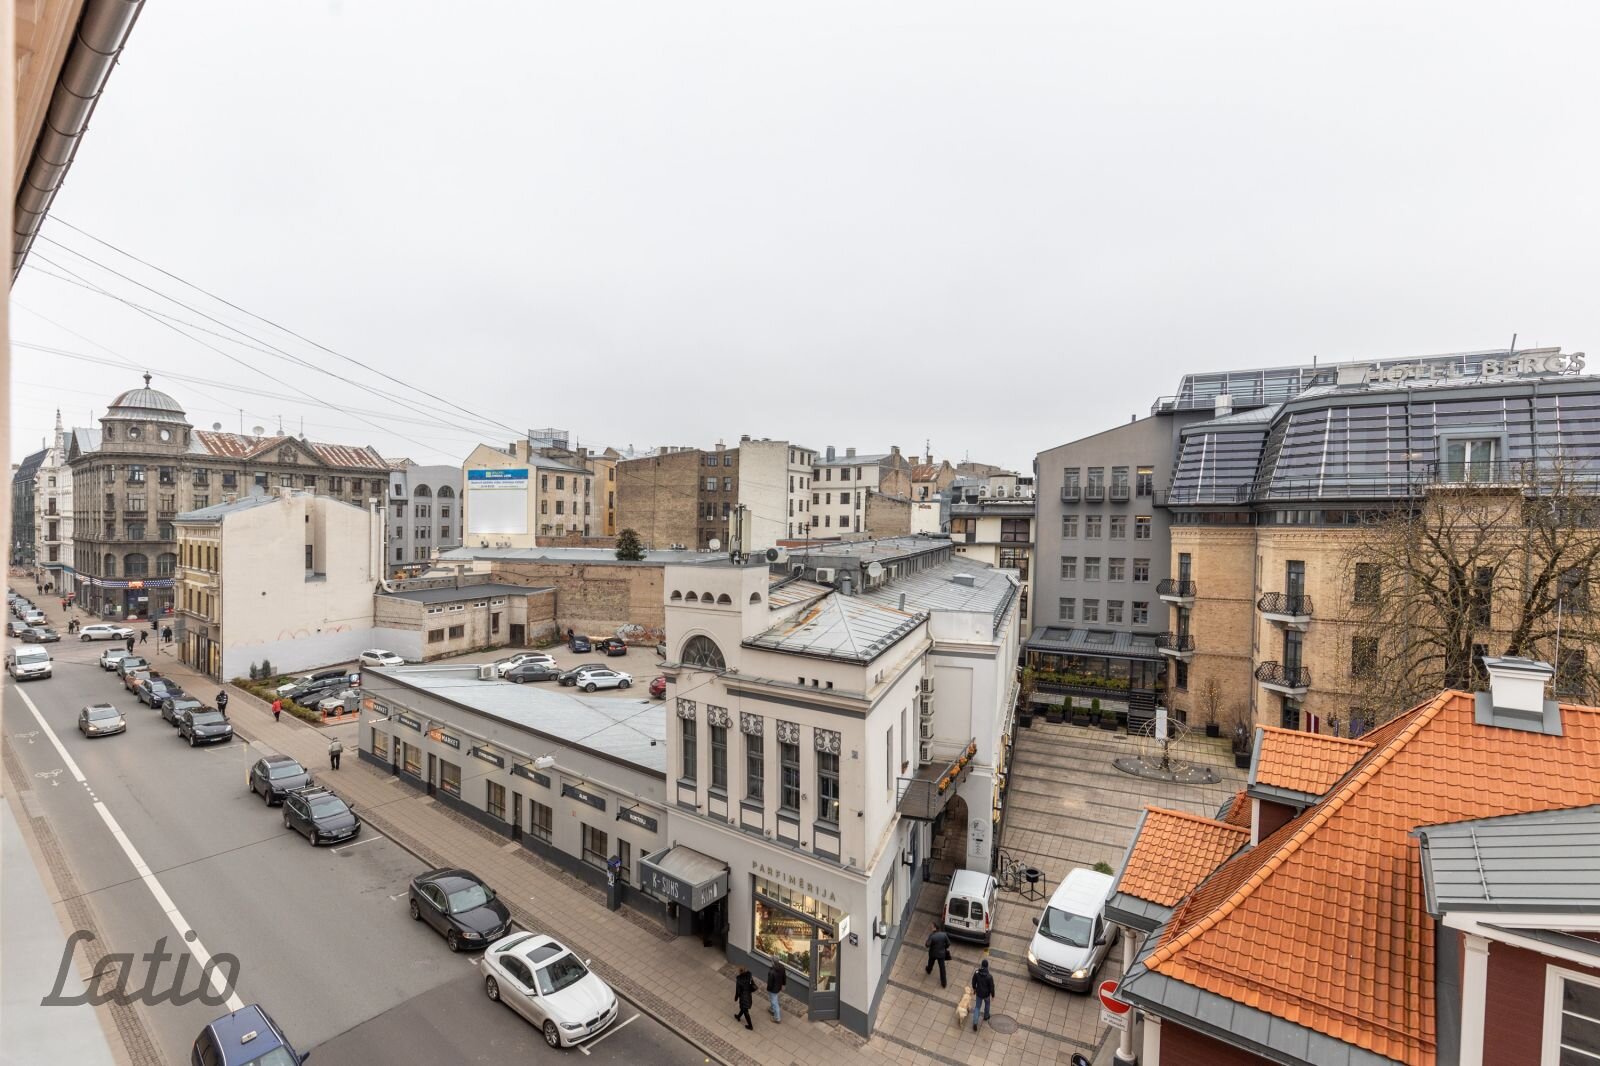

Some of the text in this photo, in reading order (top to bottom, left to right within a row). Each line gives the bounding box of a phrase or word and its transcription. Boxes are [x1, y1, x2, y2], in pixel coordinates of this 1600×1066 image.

[1366, 352, 1586, 384] HOTEL BERGS
[441, 734, 459, 748] MARKET
